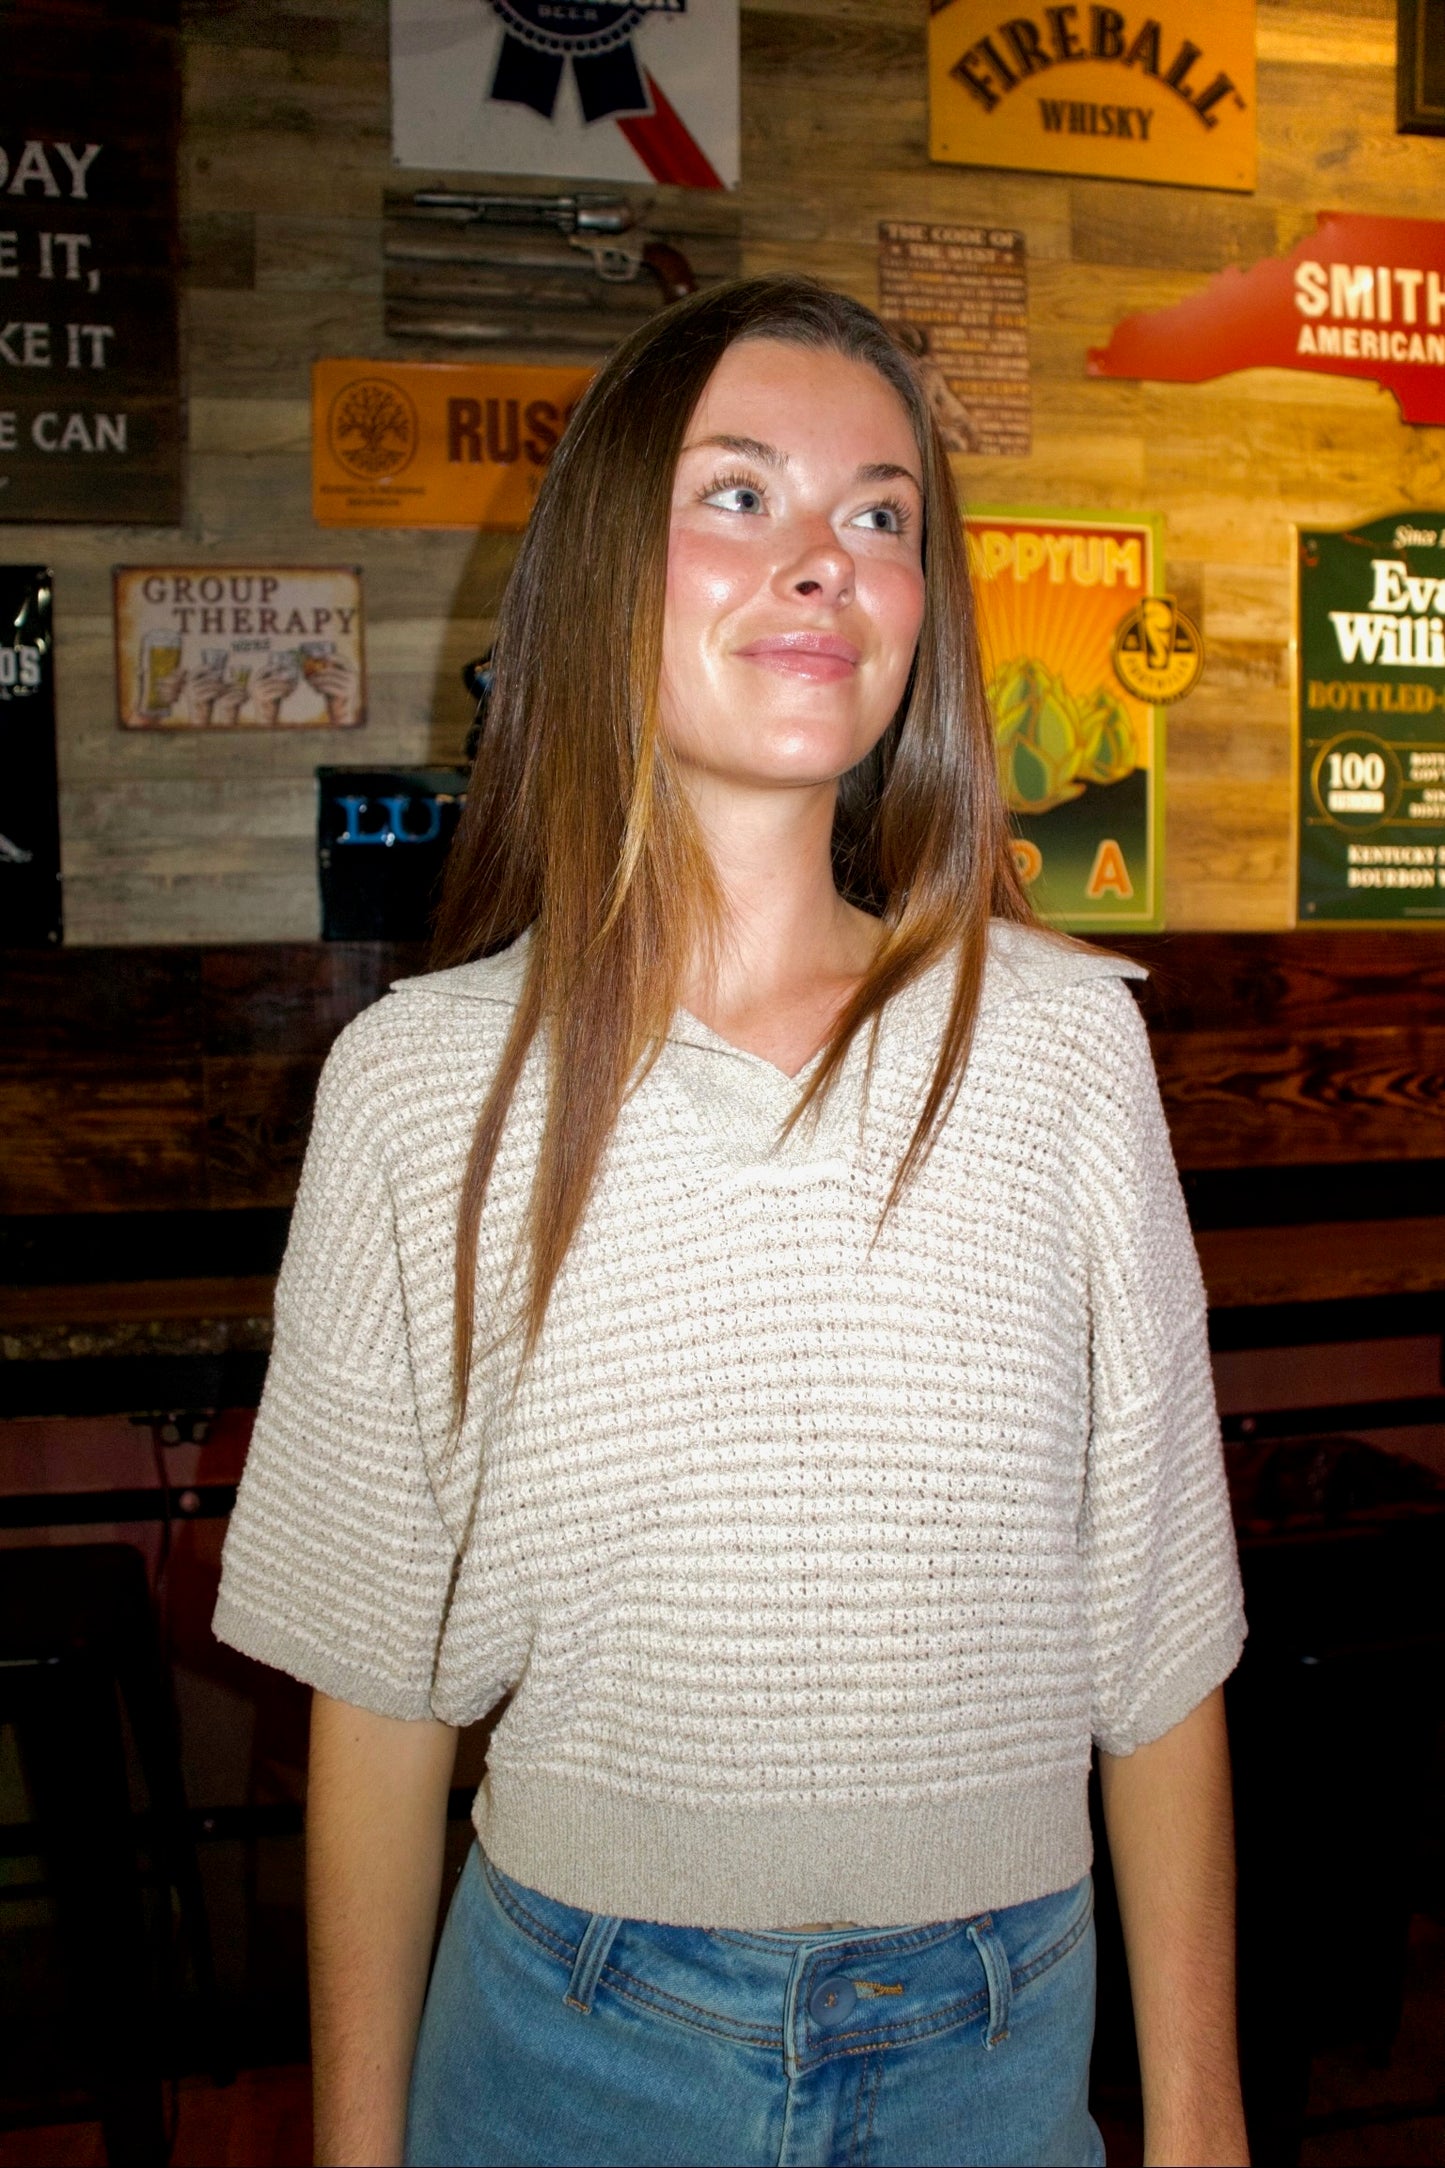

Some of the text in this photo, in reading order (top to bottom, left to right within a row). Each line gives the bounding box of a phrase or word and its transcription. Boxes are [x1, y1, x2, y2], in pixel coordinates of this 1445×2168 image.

[537, 4, 599, 21] BEER
[949, 4, 1247, 132] FIREBALL
[1039, 98, 1154, 142] WHISKY
[0, 140, 103, 199] AY
[38, 231, 100, 294] IT,
[1294, 260, 1445, 326] SMITH
[66, 323, 115, 369] IT
[1297, 323, 1445, 365] AMERICAN
[32, 413, 127, 453] CAN
[446, 397, 577, 466] RUS
[1393, 524, 1438, 550] Since
[142, 576, 279, 604] GROUP
[173, 606, 357, 635] THERAPY
[1328, 611, 1445, 667] Willi
[1327, 752, 1386, 791] 100
[1086, 839, 1135, 900] A
[1348, 844, 1436, 866] KENTUCKY
[1347, 868, 1435, 889] BOURBON
